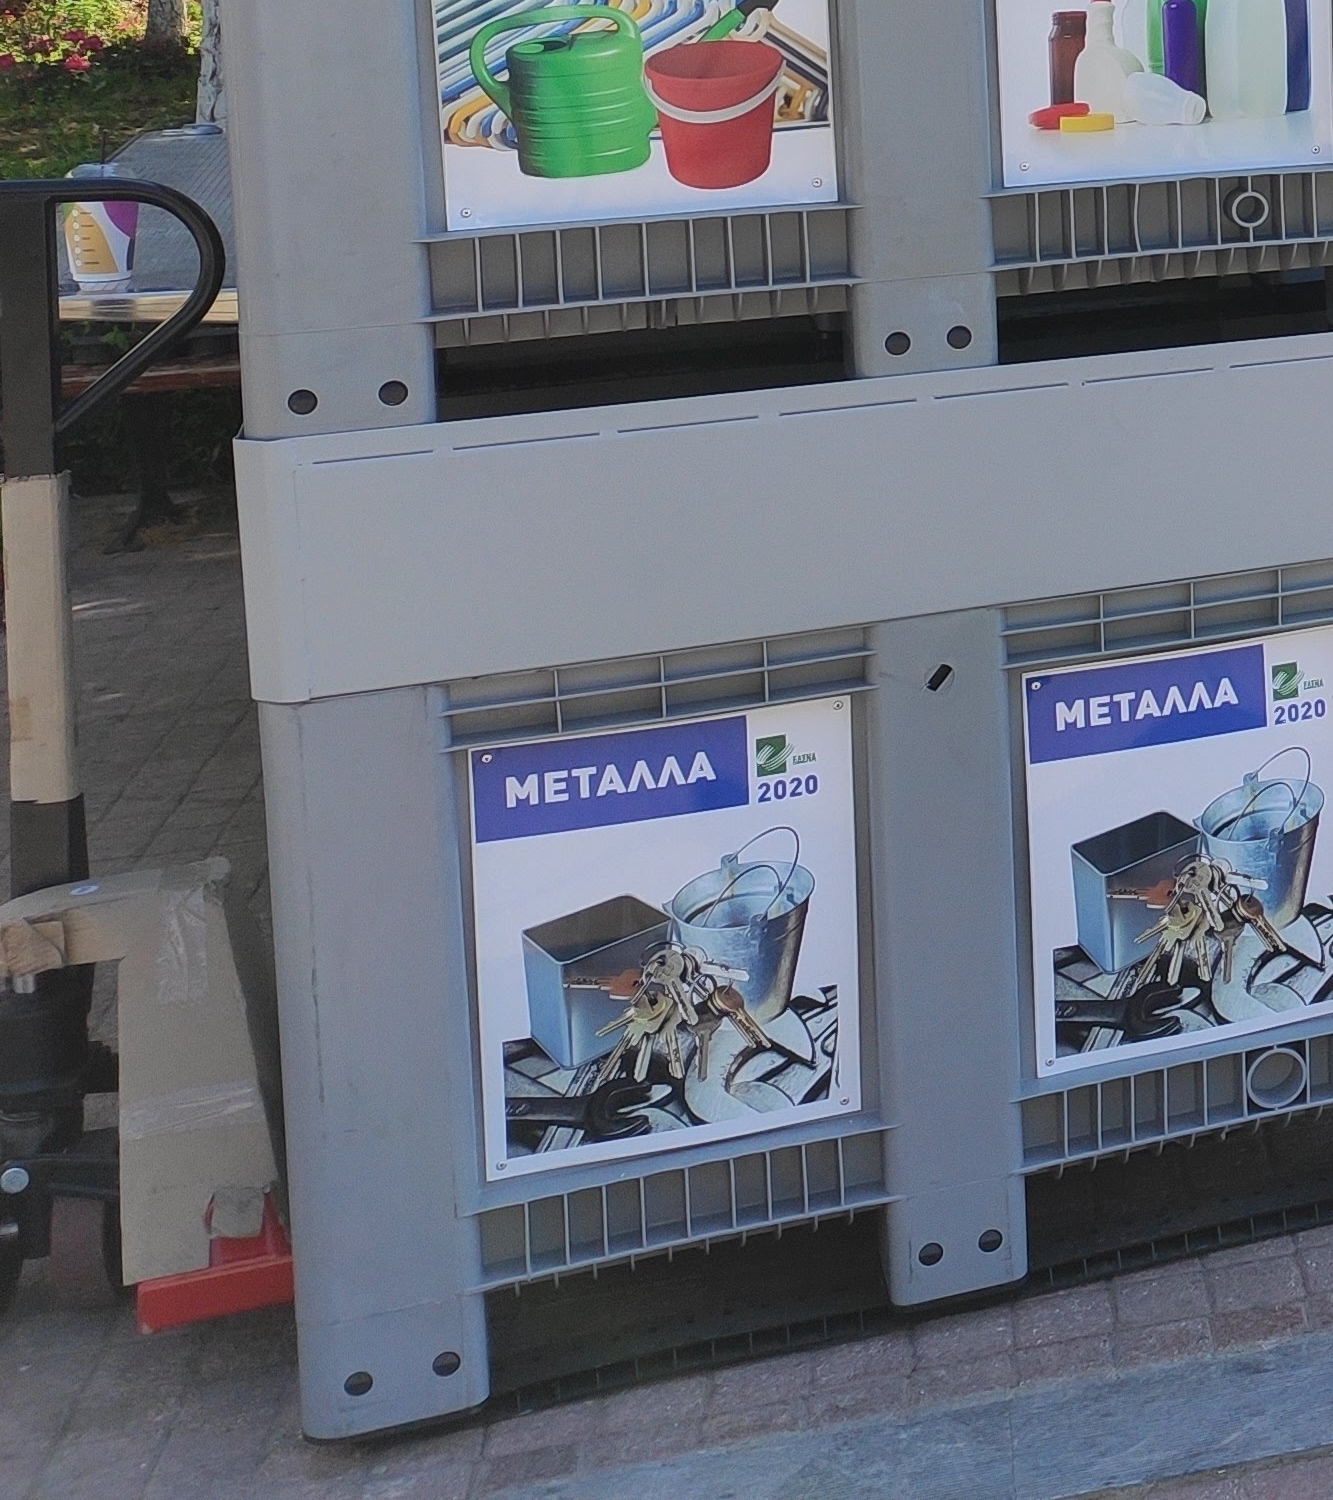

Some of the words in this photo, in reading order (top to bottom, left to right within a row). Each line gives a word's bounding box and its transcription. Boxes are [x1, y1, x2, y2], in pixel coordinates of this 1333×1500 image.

[1055, 677, 1239, 732] ΜΕΤΑΛΛΑ
[1274, 699, 1325, 726] 2020
[505, 751, 717, 809] ΜΕΤΑΛΛΑ
[758, 774, 818, 804] 2020
